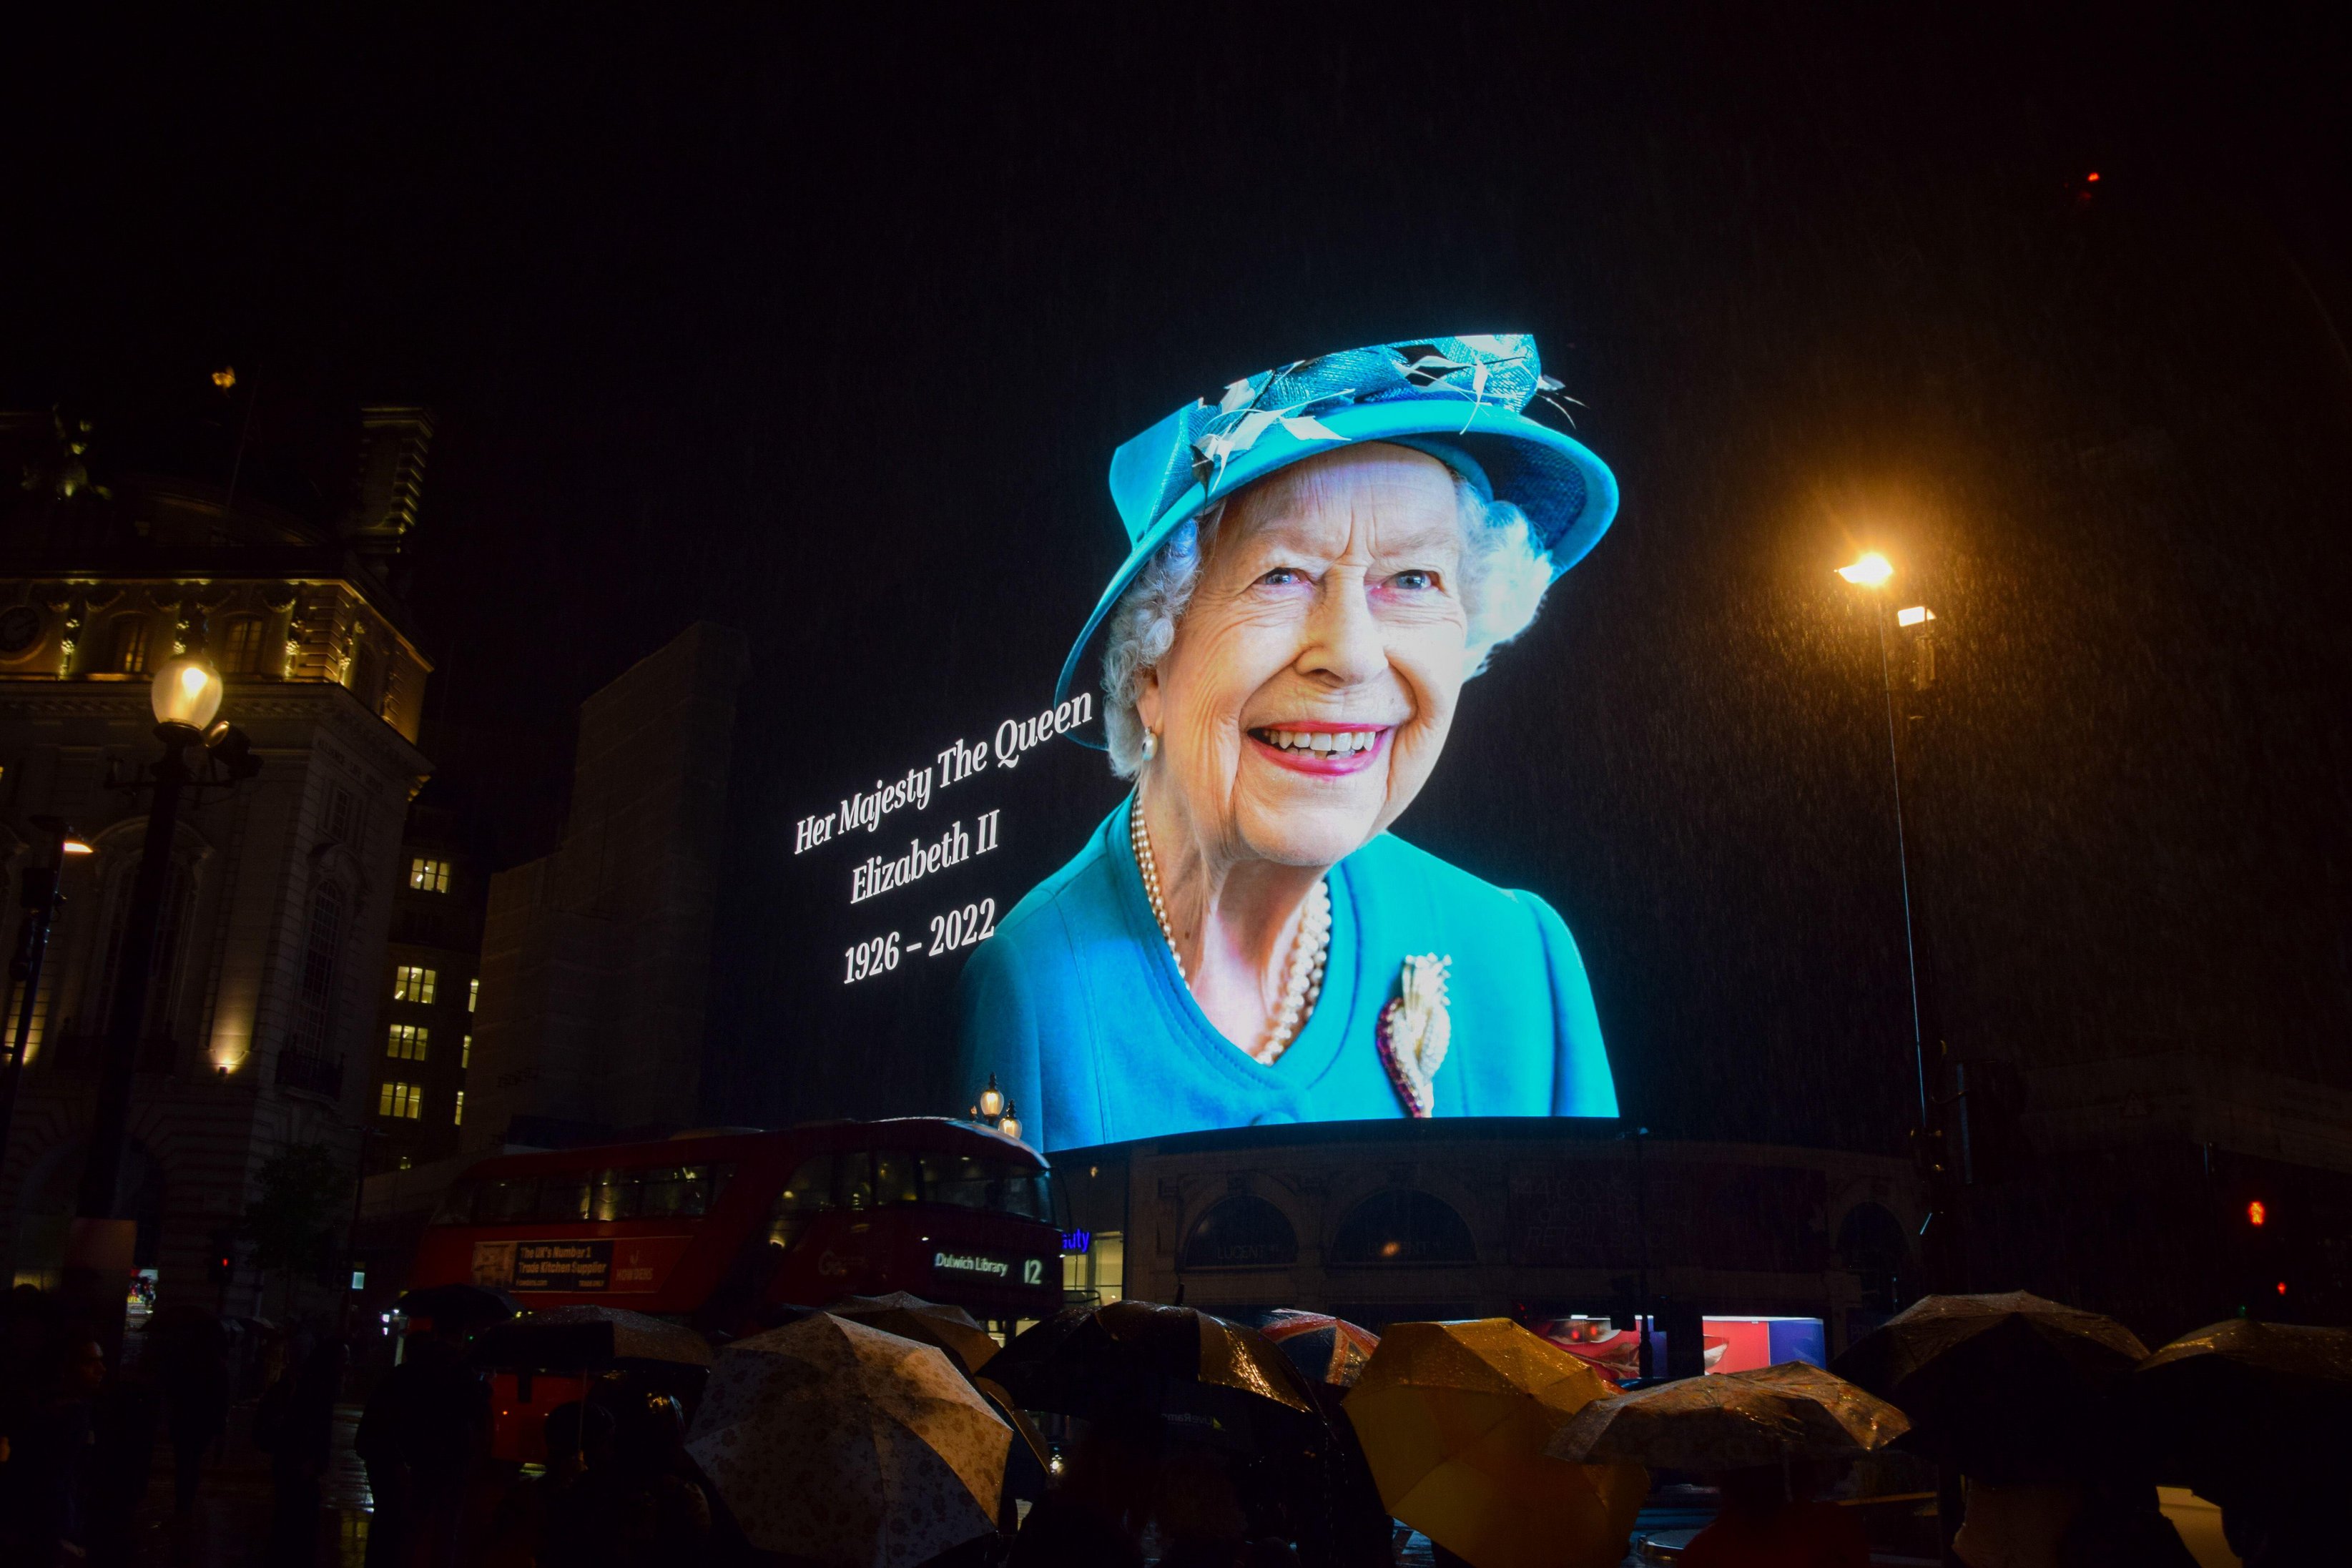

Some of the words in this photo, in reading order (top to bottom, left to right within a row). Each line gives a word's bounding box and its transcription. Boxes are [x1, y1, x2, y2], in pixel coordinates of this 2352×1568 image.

[794, 812, 836, 855] Her
[837, 766, 933, 835] Majesty
[938, 738, 988, 789] The
[995, 692, 1093, 769] Queen
[850, 821, 970, 904] Elizabeth
[975, 809, 1000, 856] II
[844, 931, 900, 985] 1926
[928, 898, 995, 957] 2022
[518, 1262, 539, 1273] Trade
[540, 1261, 570, 1273] Kitchen
[571, 1261, 607, 1276] Supplier
[521, 1247, 534, 1258] The
[553, 1246, 585, 1258] Number
[585, 1246, 592, 1258] 1
[935, 1253, 973, 1270] Dulwich
[975, 1256, 1009, 1277] Library
[1024, 1259, 1043, 1285] 12
